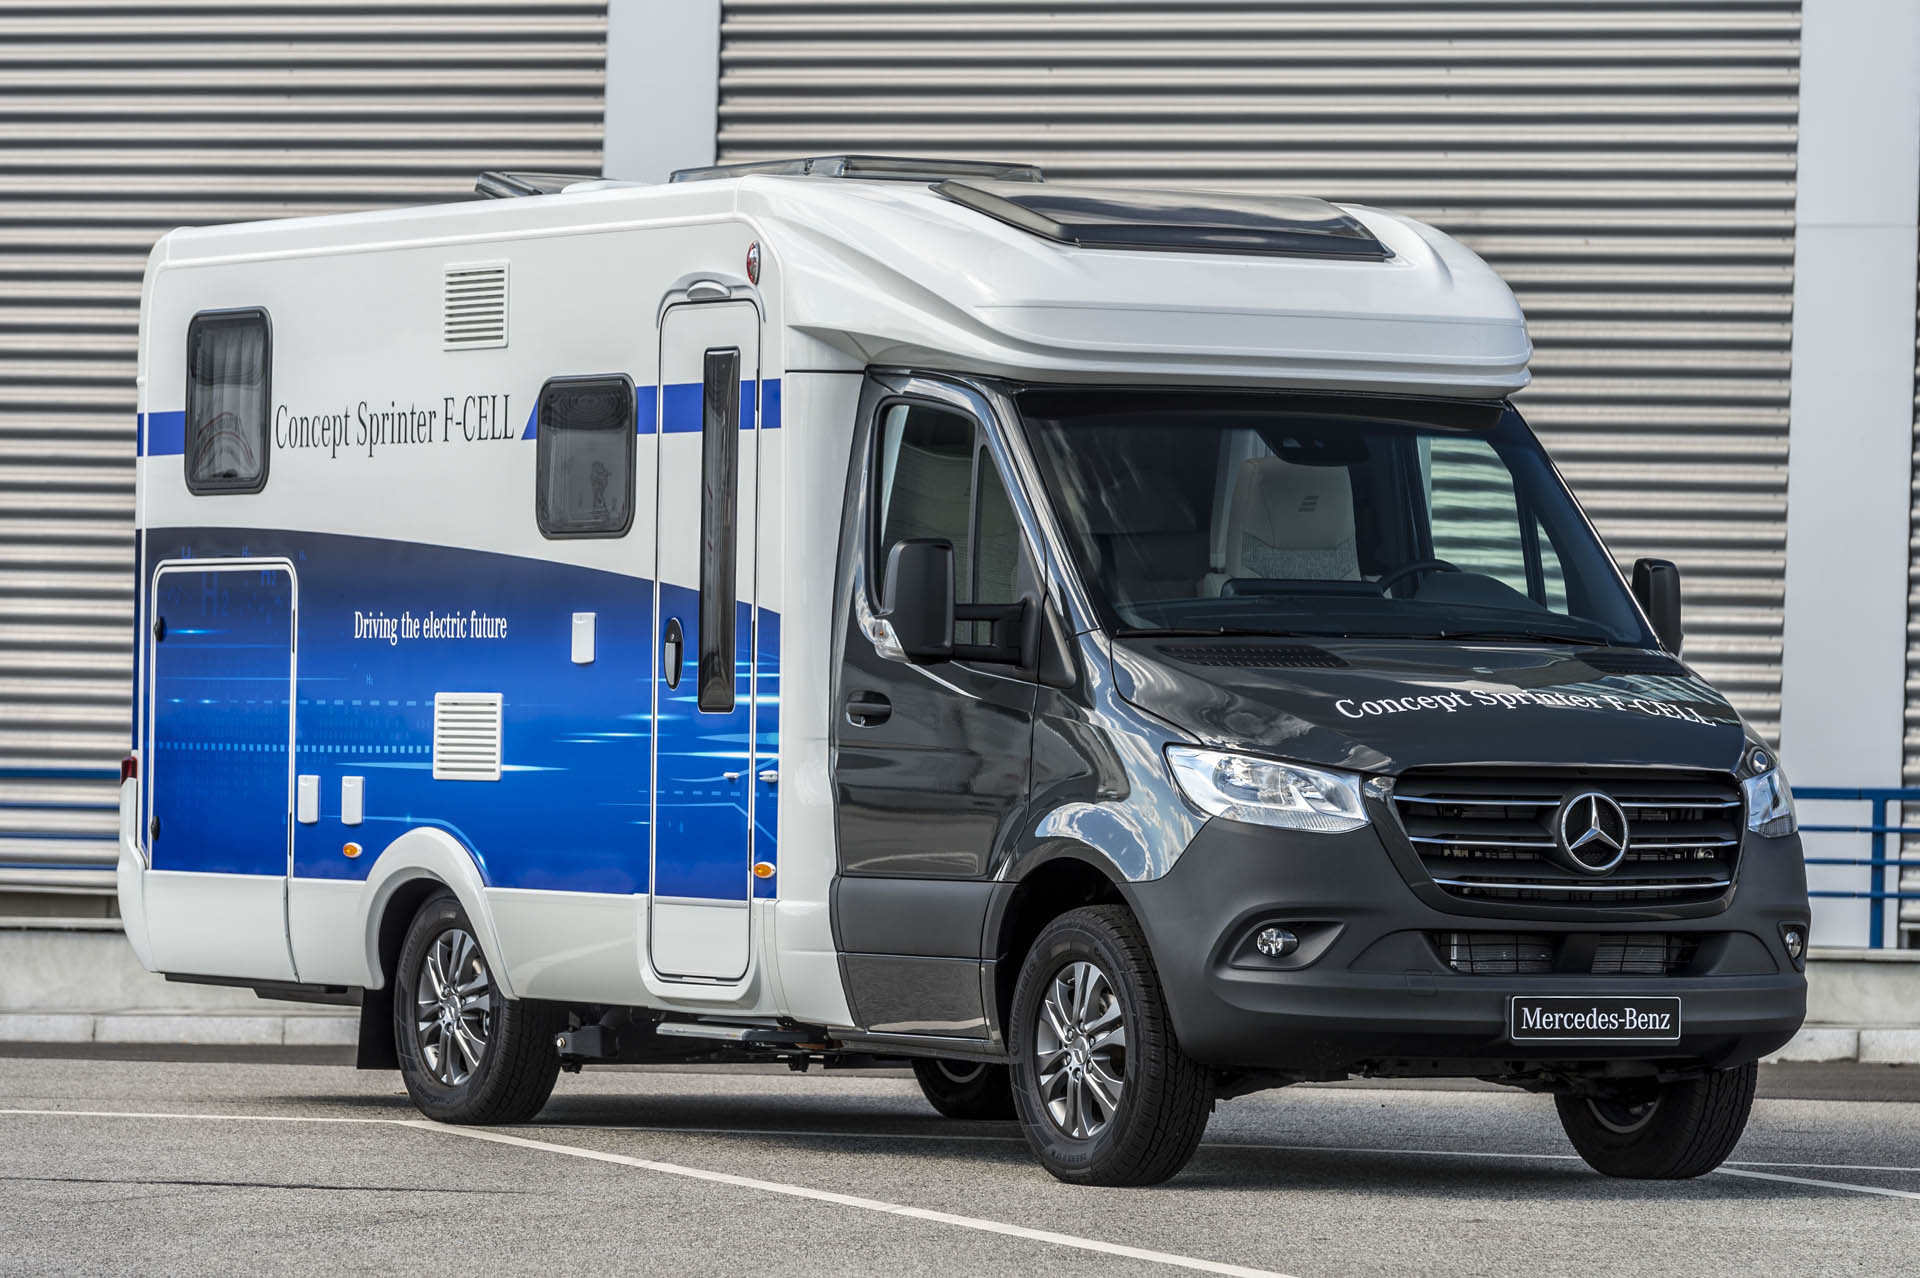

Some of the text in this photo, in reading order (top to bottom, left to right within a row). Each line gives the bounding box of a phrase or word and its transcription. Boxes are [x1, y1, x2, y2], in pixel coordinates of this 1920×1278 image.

[275, 394, 515, 459] Concept Sprinter F-CELL
[354, 610, 508, 646] Driving the electric future
[1335, 689, 1717, 727] Concept Sprinter F-CELL
[1521, 1007, 1671, 1030] Mercedes-Benz
